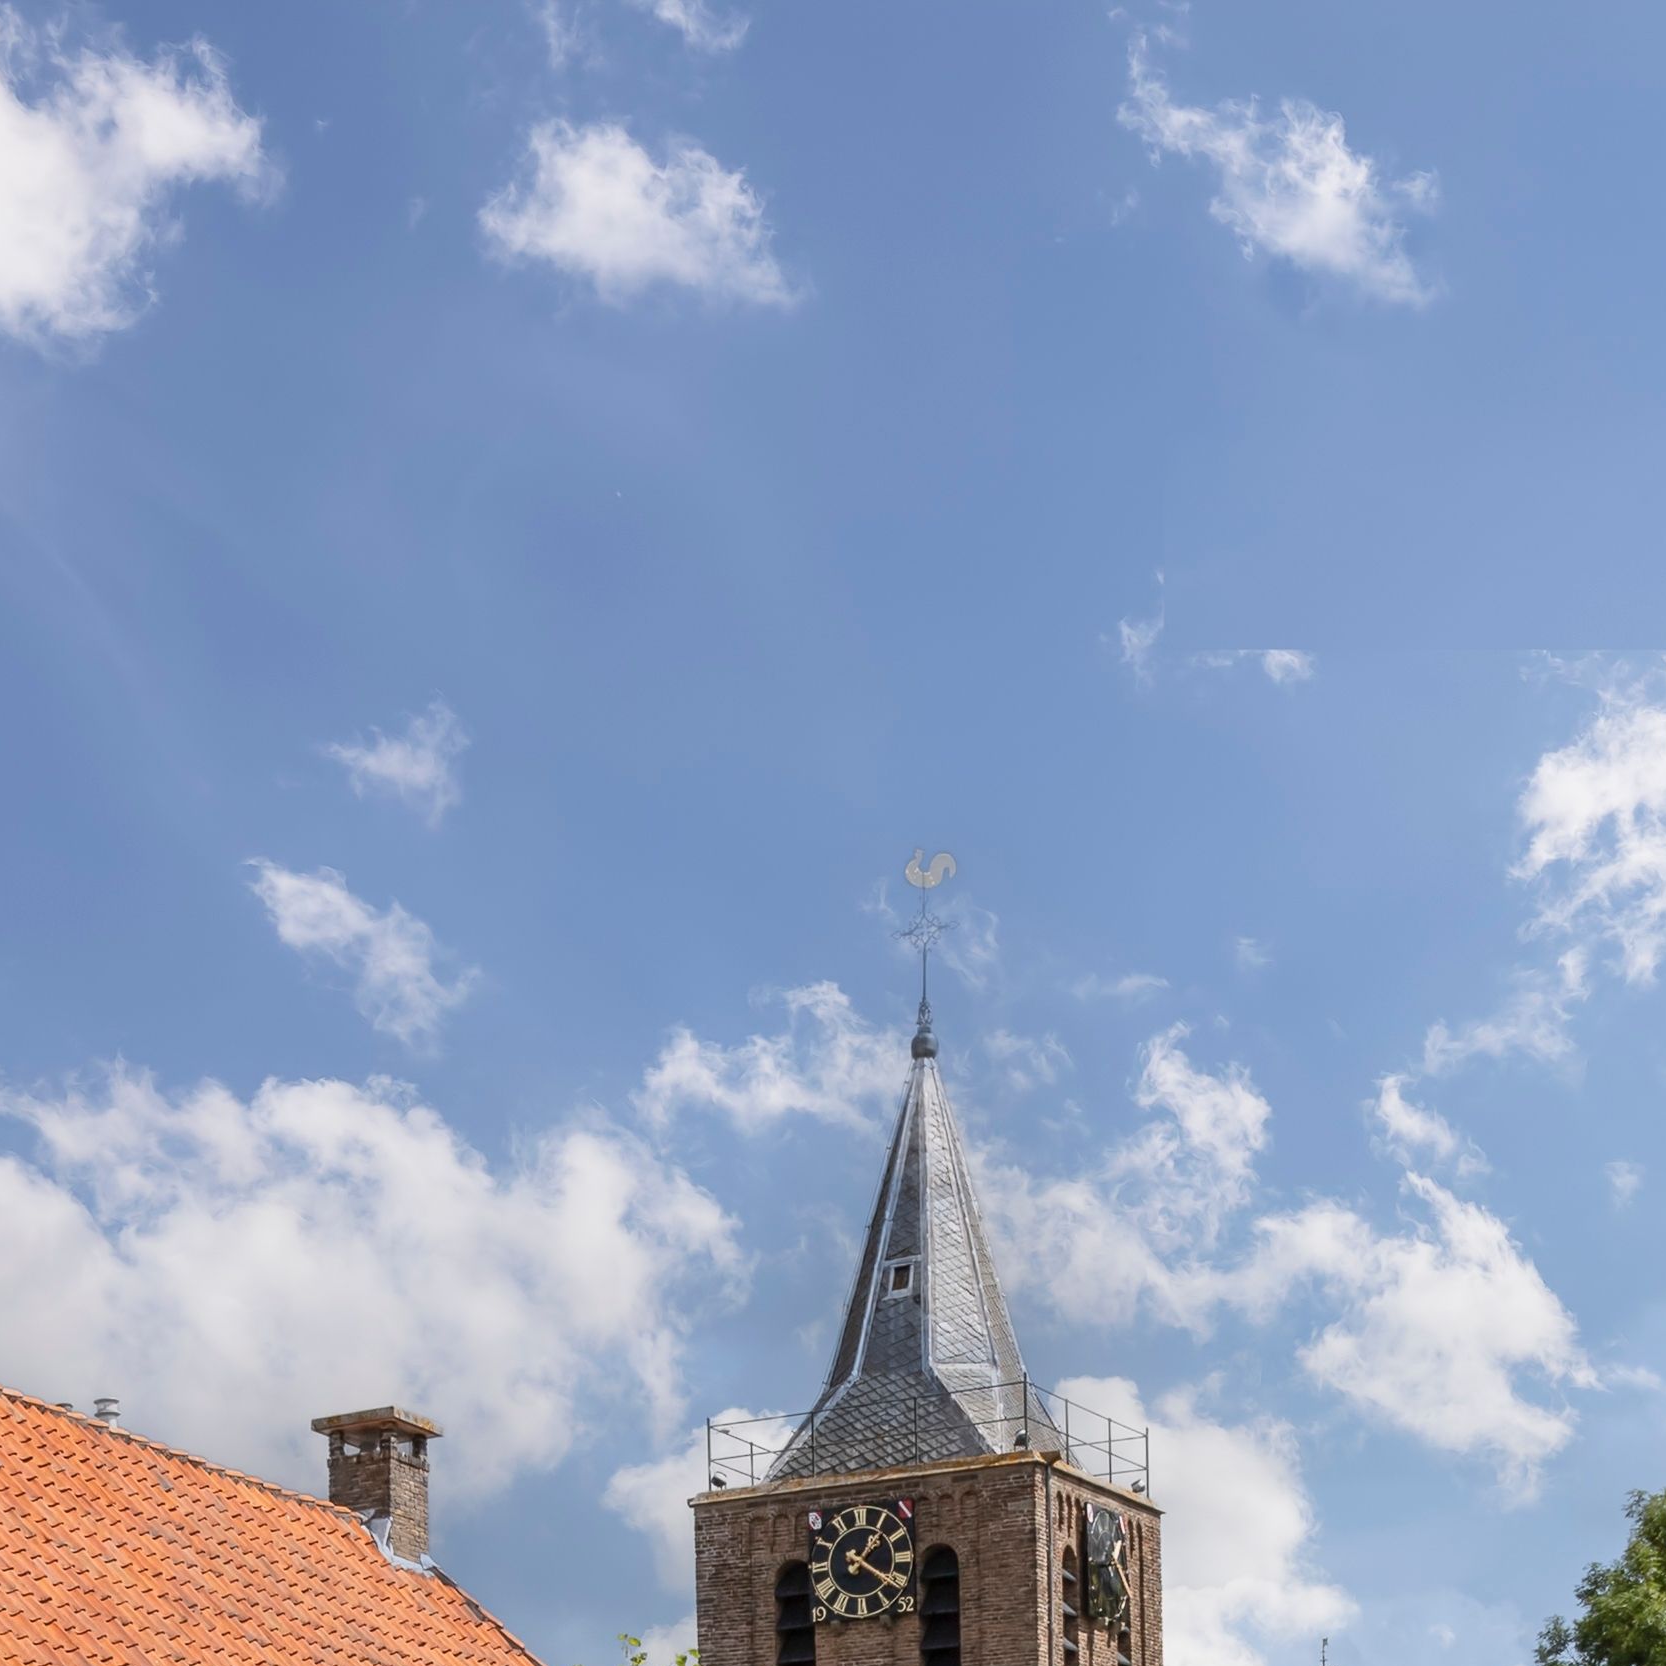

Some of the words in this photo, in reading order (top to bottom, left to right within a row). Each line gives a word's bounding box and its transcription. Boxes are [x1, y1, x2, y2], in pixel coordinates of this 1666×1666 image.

[895, 1550, 911, 1563] III
[812, 1606, 826, 1622] 19
[897, 1596, 914, 1613] 52
